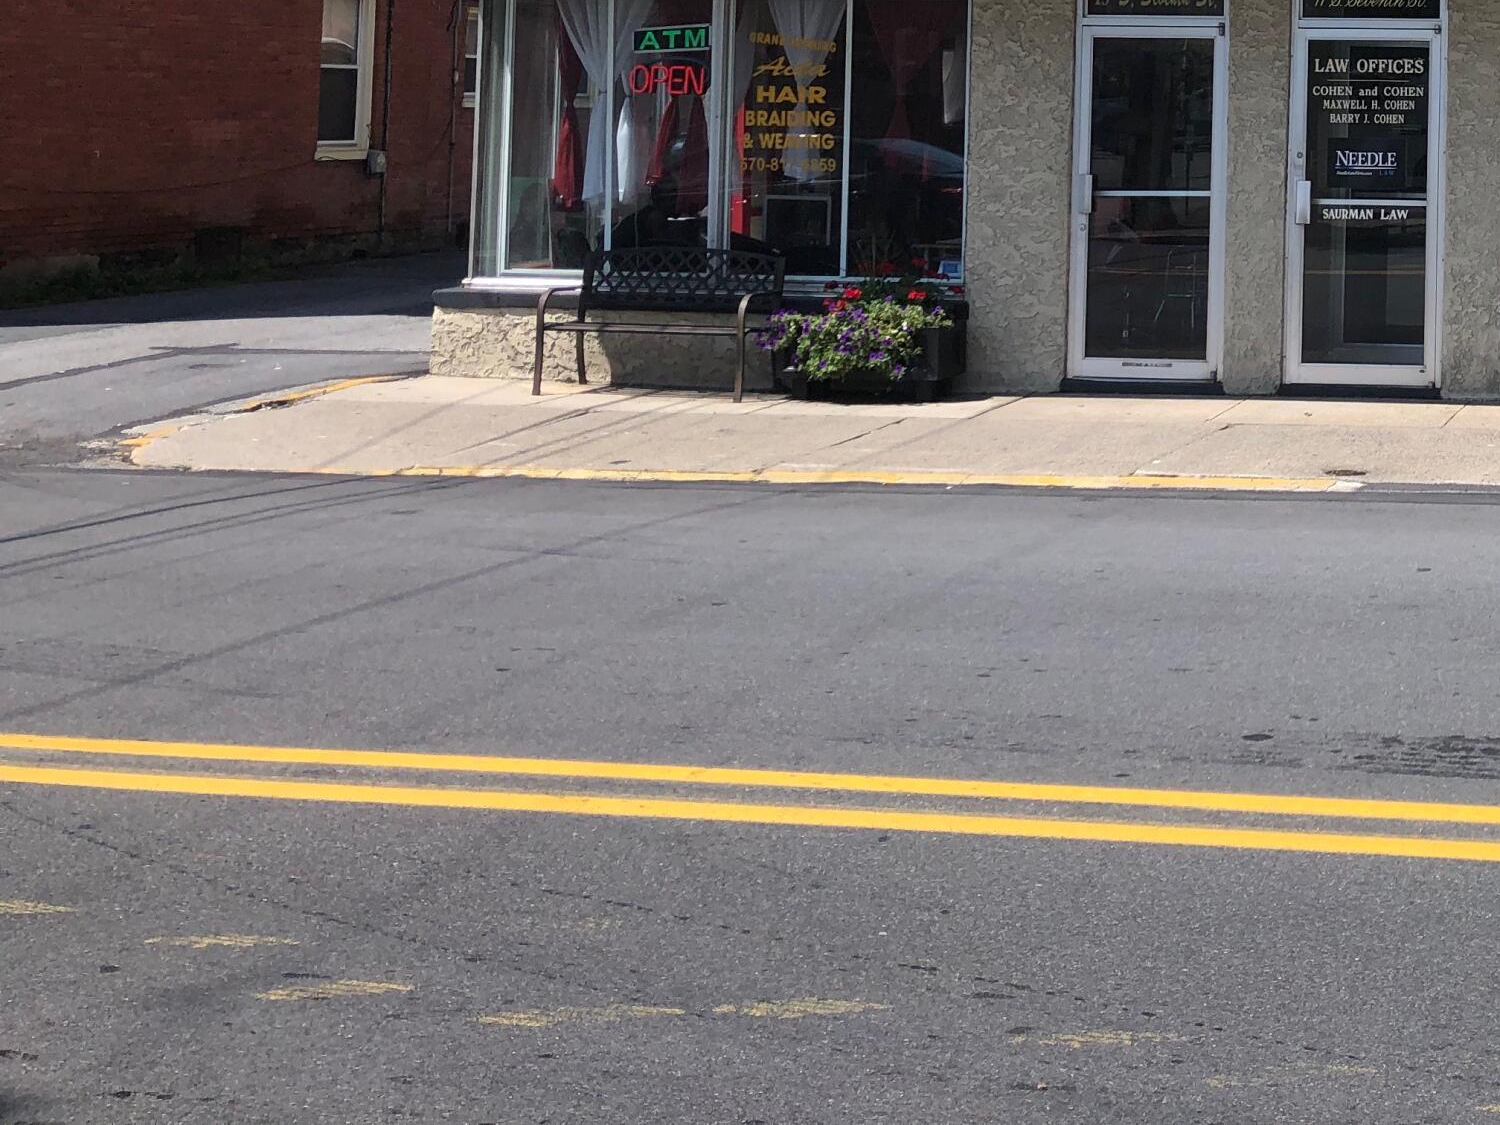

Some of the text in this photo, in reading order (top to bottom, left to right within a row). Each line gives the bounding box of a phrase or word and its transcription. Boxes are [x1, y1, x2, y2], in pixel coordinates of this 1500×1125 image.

[639, 28, 706, 50] ATM
[1314, 58, 1426, 74] LAW OFFICES
[629, 63, 705, 95] OPEN
[756, 85, 827, 104] HAIR
[1312, 86, 1424, 97] COHEN and COHEN
[1322, 99, 1415, 110] MAXWELL H. COHEN
[745, 110, 836, 127] BRAIDING
[1329, 113, 1405, 124] BARRY J. COHEN
[743, 132, 754, 149] &
[1335, 150, 1397, 167] NEEDLE
[1322, 208, 1409, 220] SAURMAN LAW
